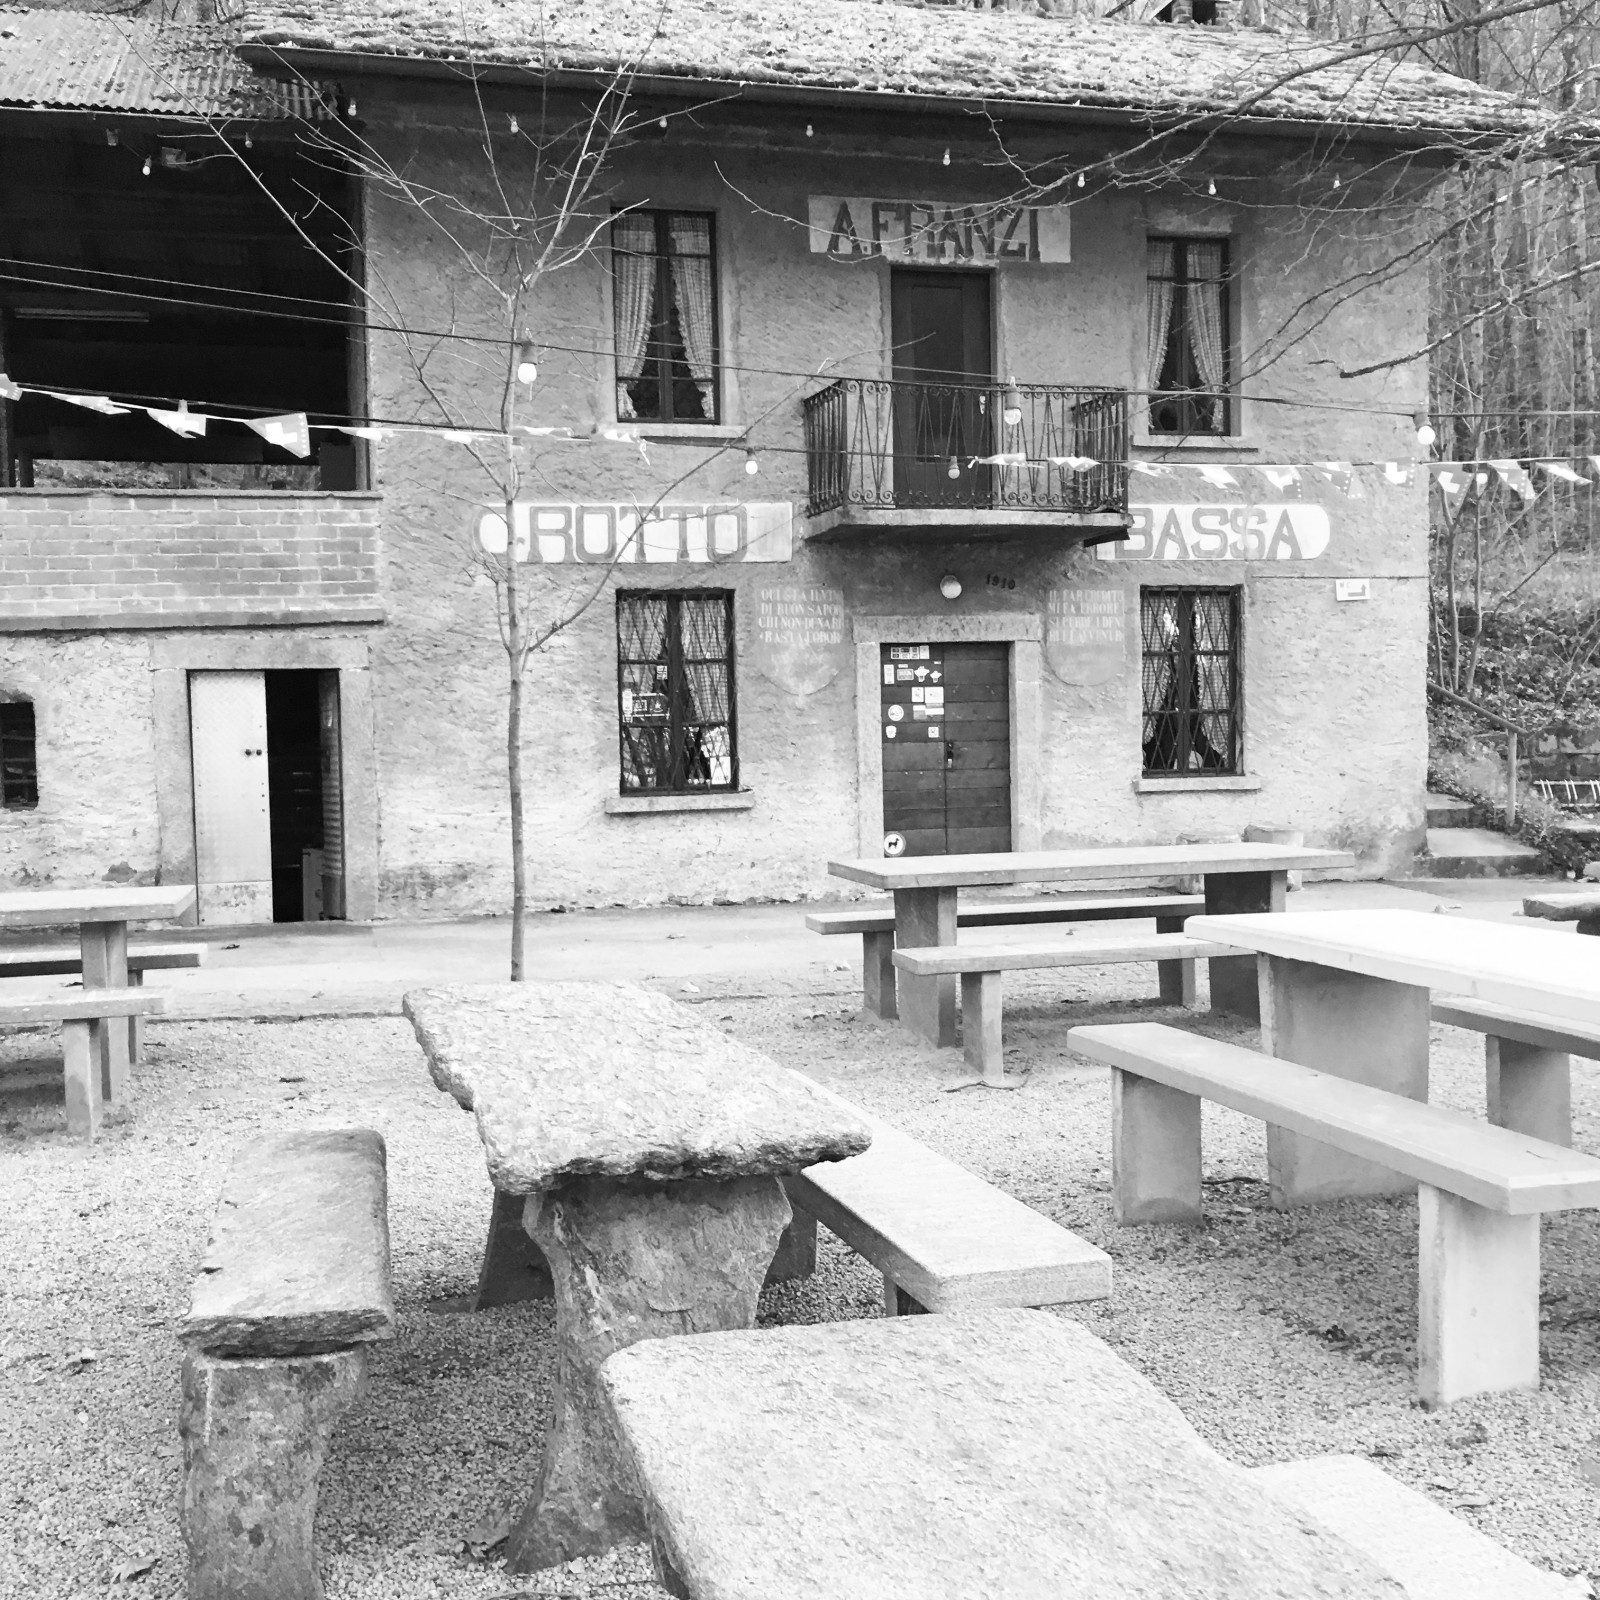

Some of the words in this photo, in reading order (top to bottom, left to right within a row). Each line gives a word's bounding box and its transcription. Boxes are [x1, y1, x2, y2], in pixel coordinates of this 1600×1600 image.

[472, 504, 748, 563] GROTTO
[1114, 507, 1303, 560] BASSA
[758, 616, 778, 628] CHI
